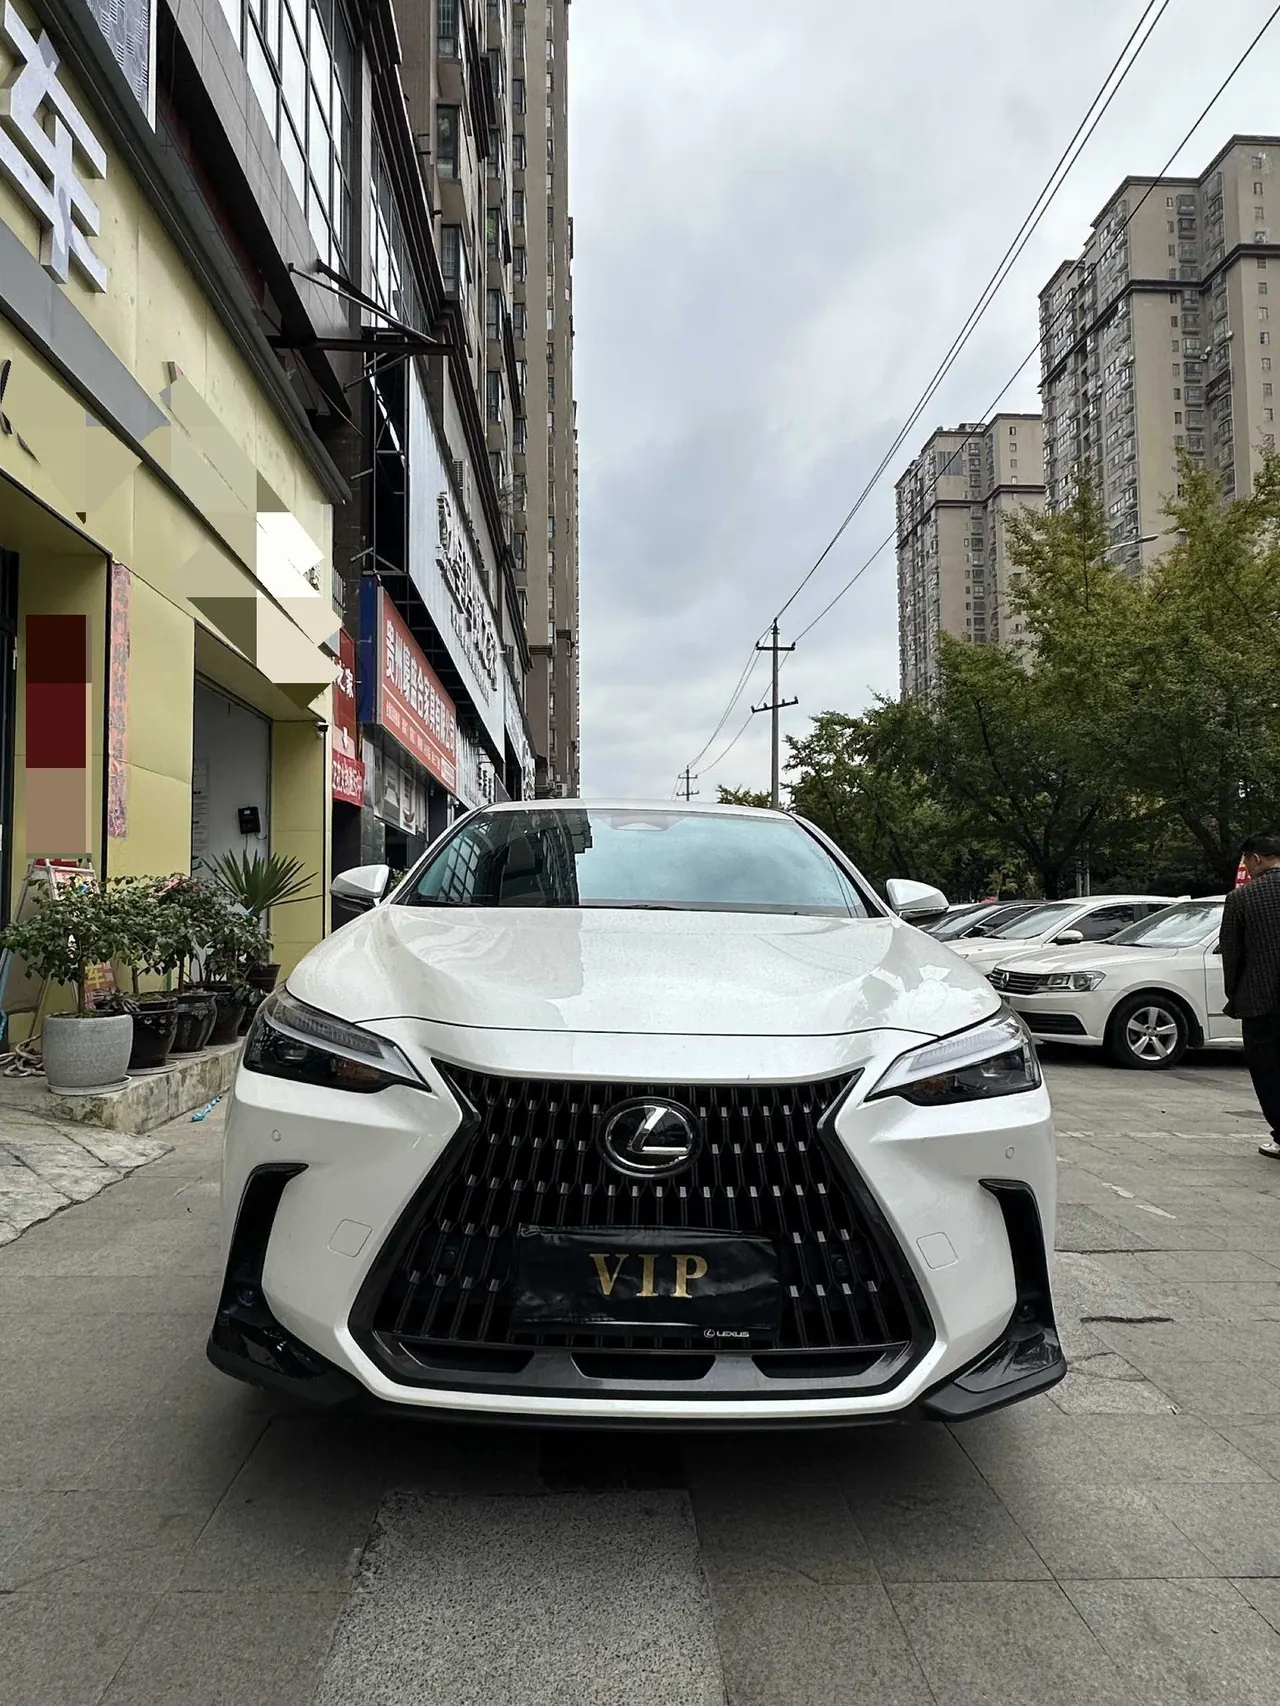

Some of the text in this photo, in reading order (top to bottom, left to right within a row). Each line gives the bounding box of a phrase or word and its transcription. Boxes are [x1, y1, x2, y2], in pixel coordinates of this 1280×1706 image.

[0, 0, 107, 293] 车
[589, 1253, 708, 1298] VIP
[716, 1330, 750, 1338] LEXUS
